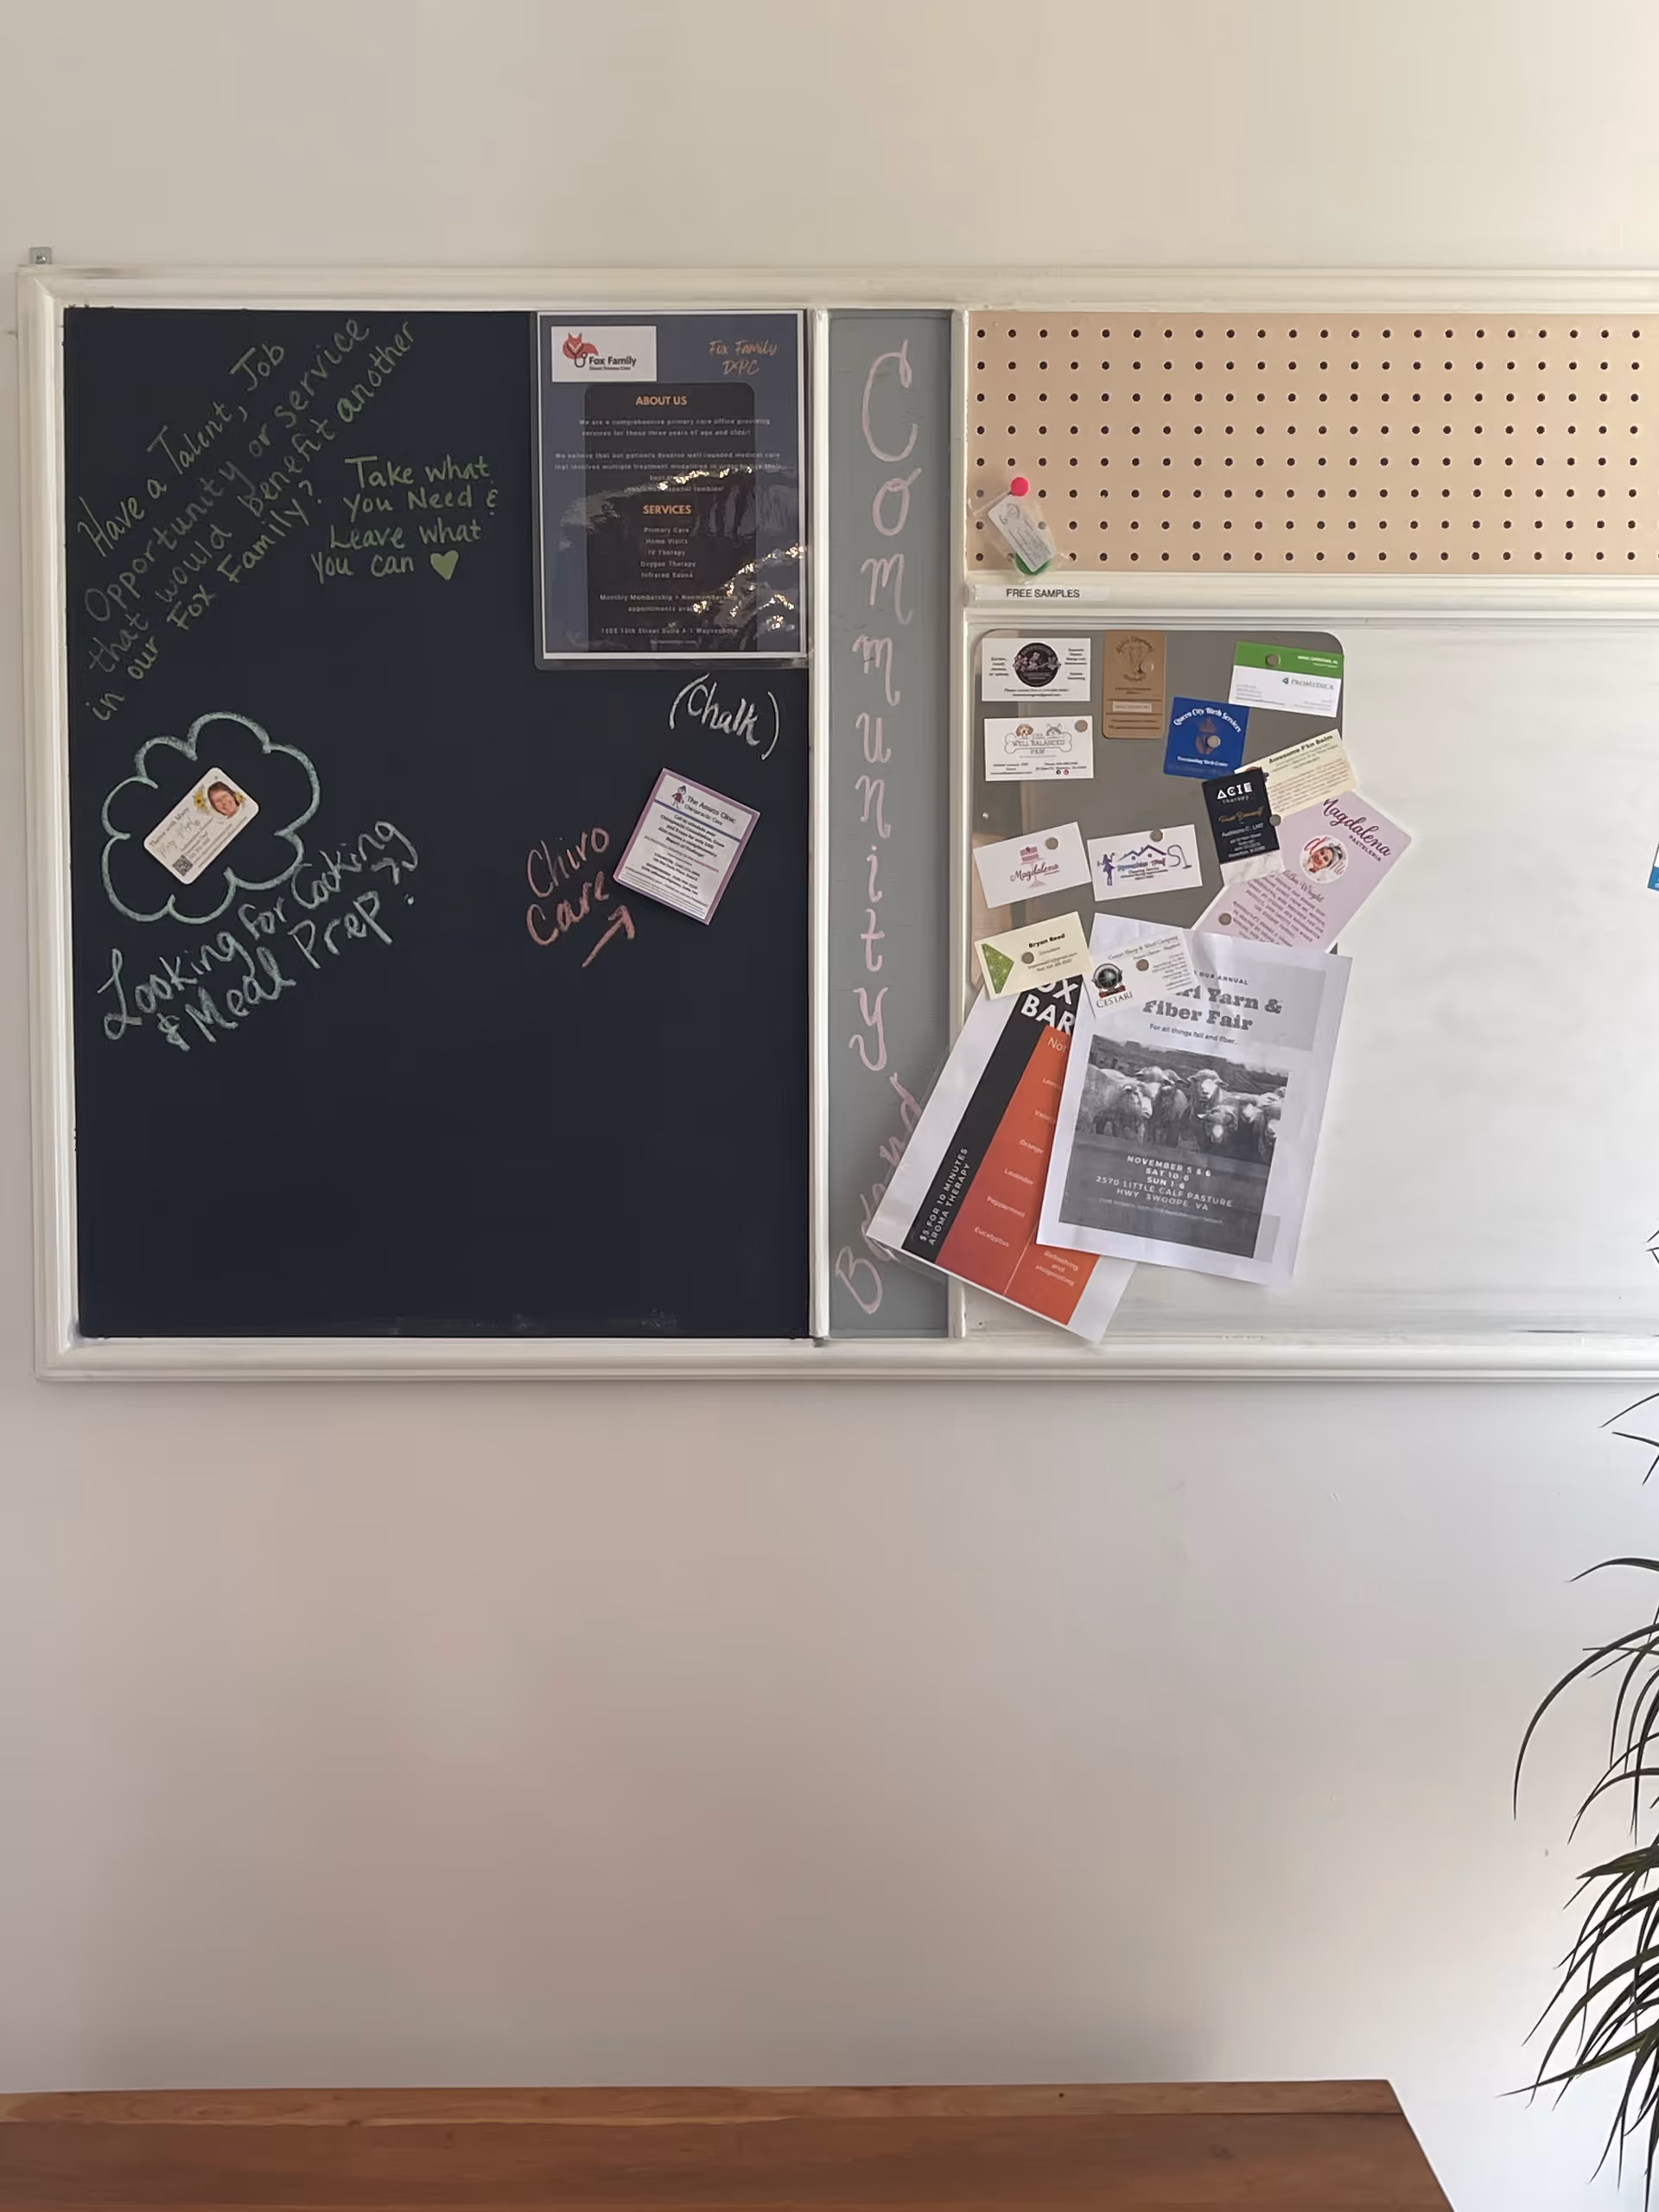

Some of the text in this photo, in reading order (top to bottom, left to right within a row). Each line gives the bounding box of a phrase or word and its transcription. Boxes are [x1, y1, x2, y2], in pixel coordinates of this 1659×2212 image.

[709, 340, 779, 356] Fox Family
[589, 355, 637, 367] Fox Family
[635, 396, 688, 406] ABOUT US
[78, 343, 285, 557] Have a Talent, Job
[85, 317, 370, 623] Opportunity or service
[344, 455, 416, 489] Take
[87, 321, 415, 674] that would benefit another
[407, 485, 474, 512] Need
[642, 505, 692, 515] SERVICES
[329, 524, 405, 550] Leave
[644, 526, 671, 535] Primary
[658, 549, 686, 557] Therapy
[669, 560, 696, 569] Therapy
[370, 553, 415, 578] can
[1006, 588, 1081, 598] FREE SAMPLES
[85, 691, 125, 722] in
[126, 634, 163, 681] our
[165, 583, 217, 631] Fox
[1173, 711, 1192, 726] Queen
[1222, 712, 1242, 733] Services
[720, 811, 737, 825] Clinic
[526, 826, 611, 899] Chiro
[1009, 861, 1059, 883] Magdalena
[525, 870, 610, 947] Care
[97, 930, 257, 1040] Looking
[290, 819, 419, 910] Cooking
[1028, 932, 1066, 949] Bryan Reed
[1217, 976, 1249, 986] ANNUAL
[184, 946, 297, 1043] Meal
[1096, 991, 1133, 1008] CESTARI
[1207, 987, 1283, 1014] Yarn &
[1020, 993, 1076, 1036] BAR
[1141, 1000, 1254, 1031] Fiber Fair
[1149, 1022, 1161, 1031] For
[1171, 1027, 1192, 1038] things
[1205, 1033, 1218, 1042] and
[1127, 1155, 1185, 1173] NOVEMBER
[1145, 1167, 1165, 1177] SAT
[926, 1207, 940, 1228] FOR
[936, 1193, 947, 1205] 10
[943, 1147, 968, 1192] MINUTES
[1096, 1175, 1234, 1209] 2570 LITTLE CALF PASTURE
[1147, 1176, 1167, 1187] SUN
[928, 1163, 971, 1246] AROMA THERAPY
[1116, 1188, 1210, 1211] HWY SWOOPE VA
[974, 1225, 1010, 1249] Eucalyptus
